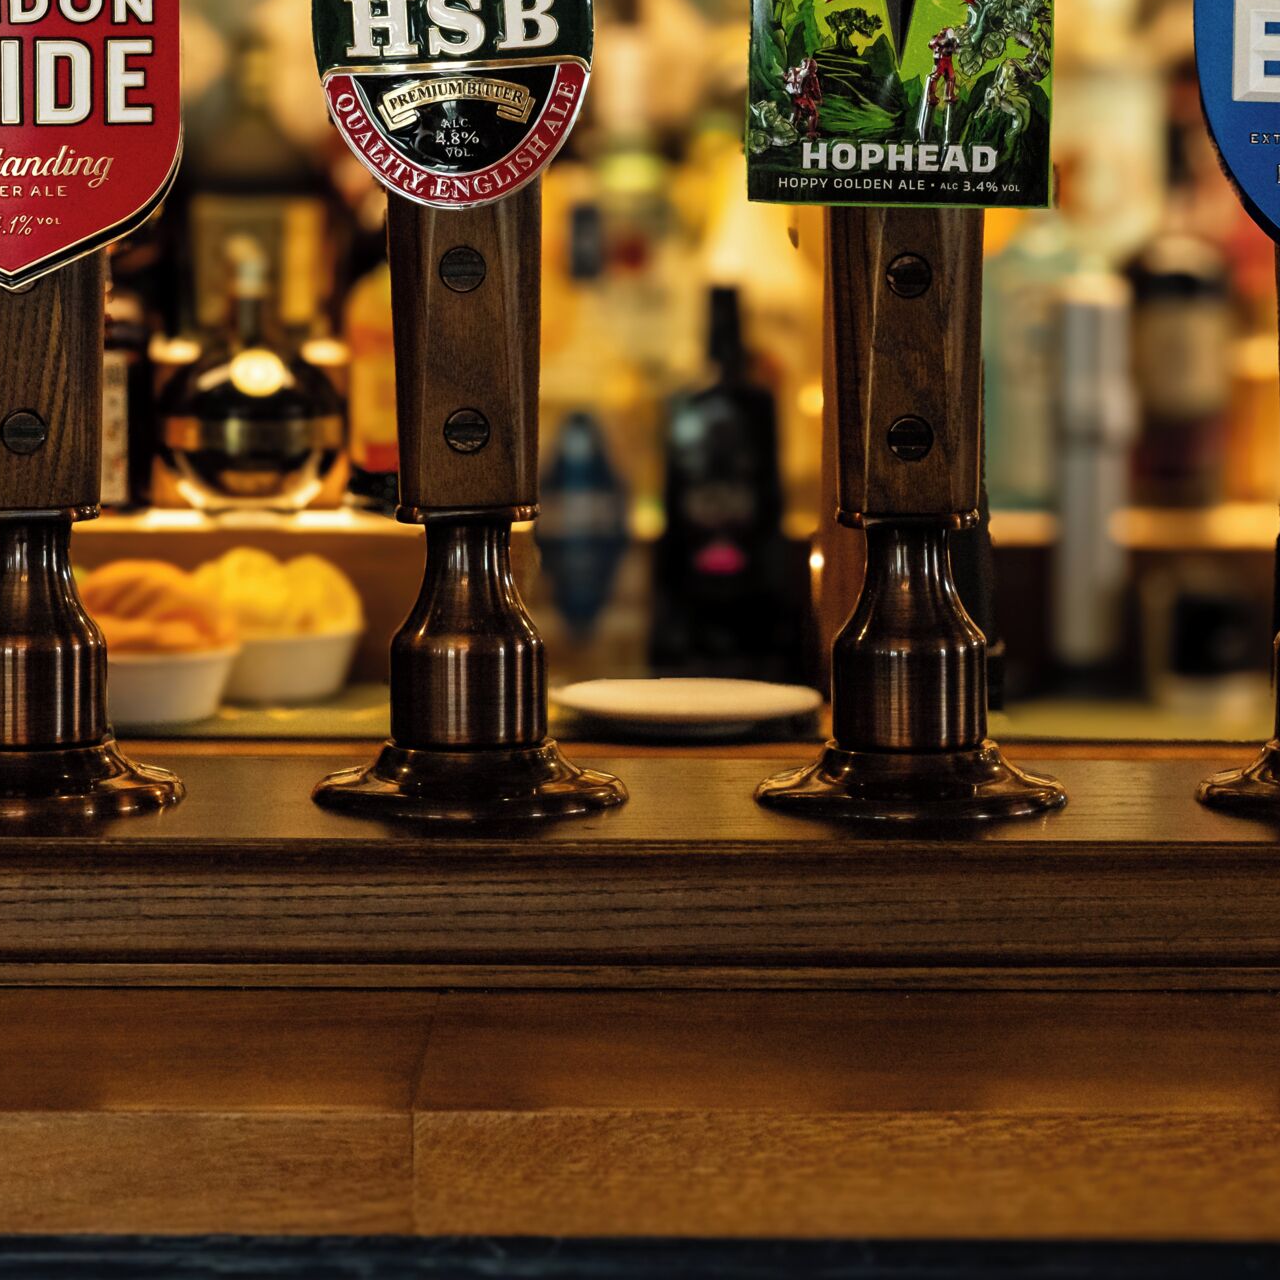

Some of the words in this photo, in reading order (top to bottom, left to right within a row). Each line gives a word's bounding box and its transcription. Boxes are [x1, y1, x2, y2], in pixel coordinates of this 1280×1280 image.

[389, 79, 464, 111] PREMIUM
[466, 80, 523, 105] BITTER
[440, 118, 472, 129] ALC.
[334, 91, 427, 194] QUALITY
[435, 136, 550, 199] ENGLISH
[546, 81, 577, 136] ALE
[434, 130, 480, 146] 4.8%
[445, 147, 475, 158] VOL.
[801, 141, 999, 173] HOPHEAD
[30, 185, 68, 198] ALE
[778, 177, 828, 189] HOPPY
[833, 178, 893, 190] GOLDEN
[898, 179, 926, 191] ALE
[939, 182, 959, 191] ALC
[962, 180, 999, 193] 3.4%
[1001, 184, 1020, 192] VOL
[36, 216, 62, 226] VOL
